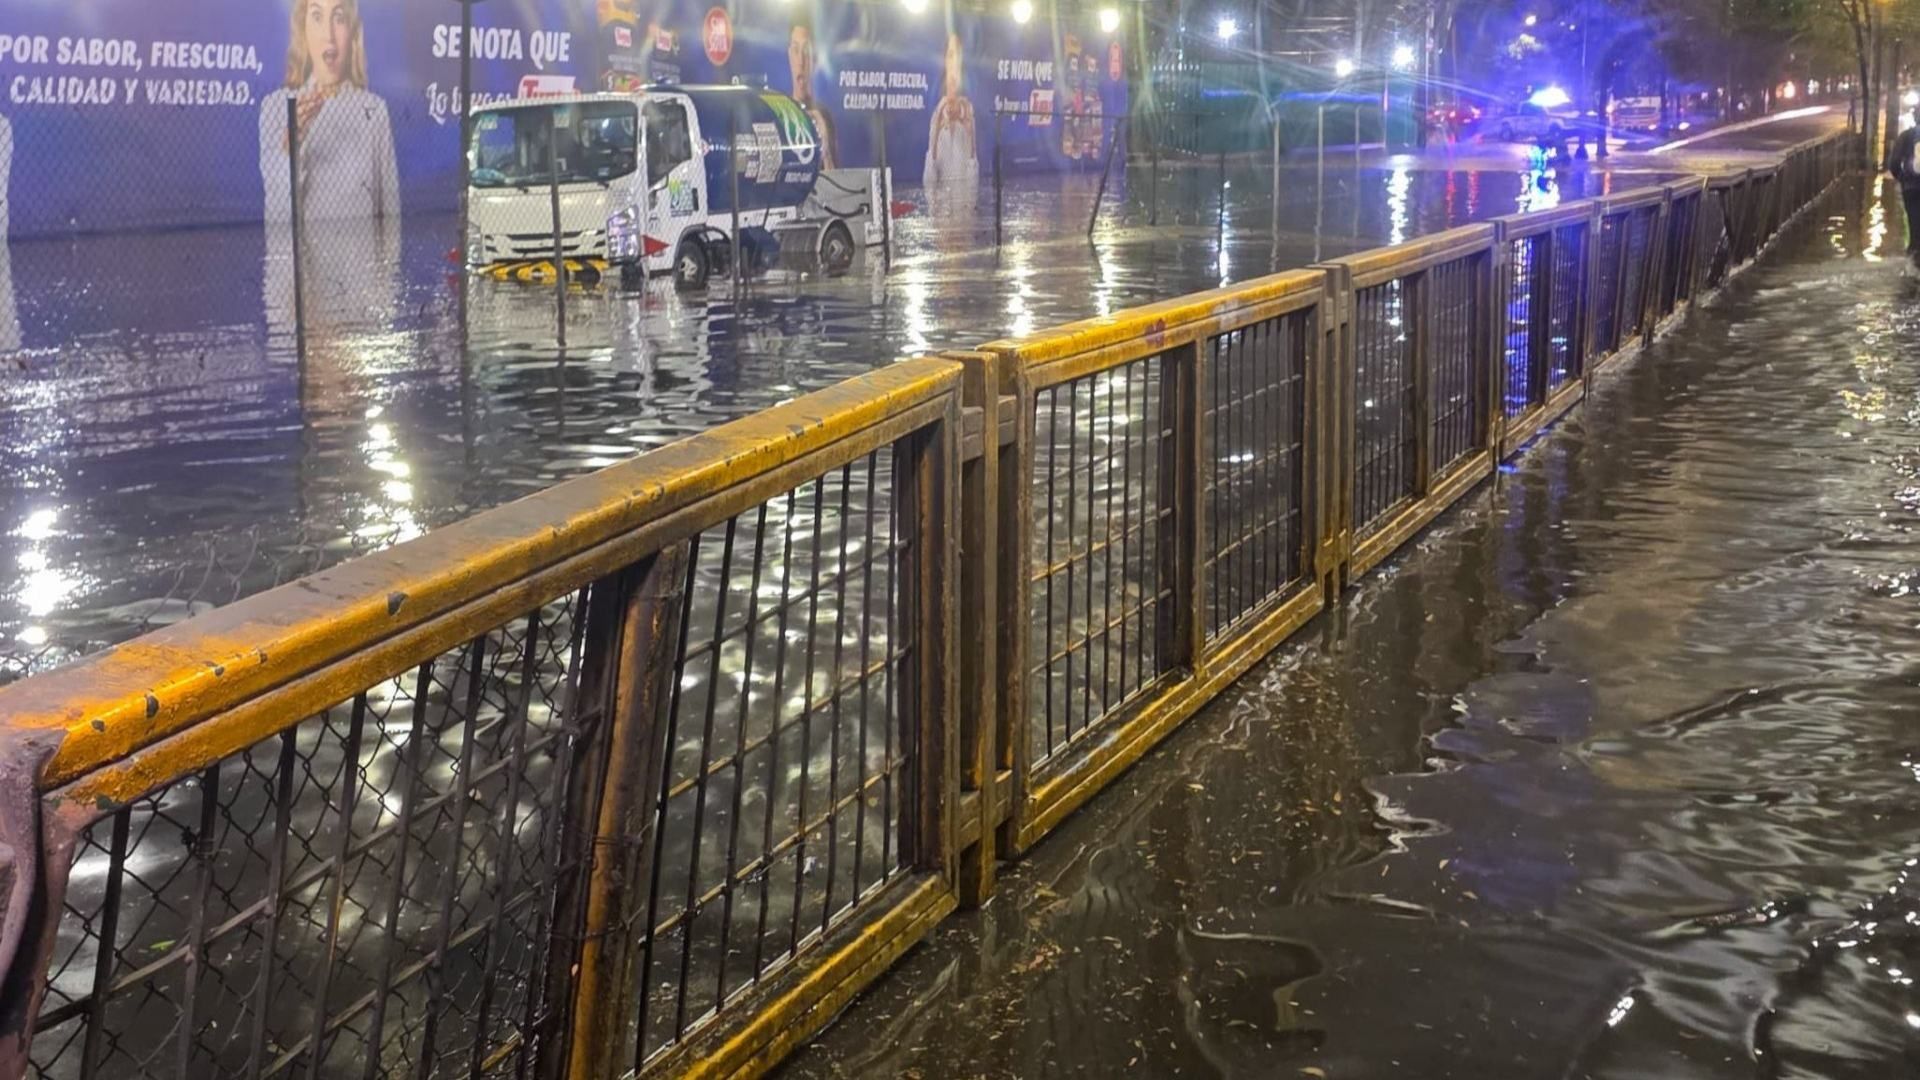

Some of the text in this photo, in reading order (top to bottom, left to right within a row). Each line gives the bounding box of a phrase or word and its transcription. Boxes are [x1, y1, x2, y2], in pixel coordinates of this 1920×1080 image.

[0, 34, 263, 75] POR SABOR, FRESCURA,
[432, 24, 462, 58] SE
[469, 27, 523, 60] NOTA
[529, 30, 571, 70] QUE
[840, 70, 929, 91] POR SABOR, FRESCURA,
[997, 60, 1053, 87] SE NOTA QUE
[10, 75, 255, 105] CALIDAD Y VARIEDAD.
[843, 93, 925, 110] CALIDAD Y VARIEDAD.
